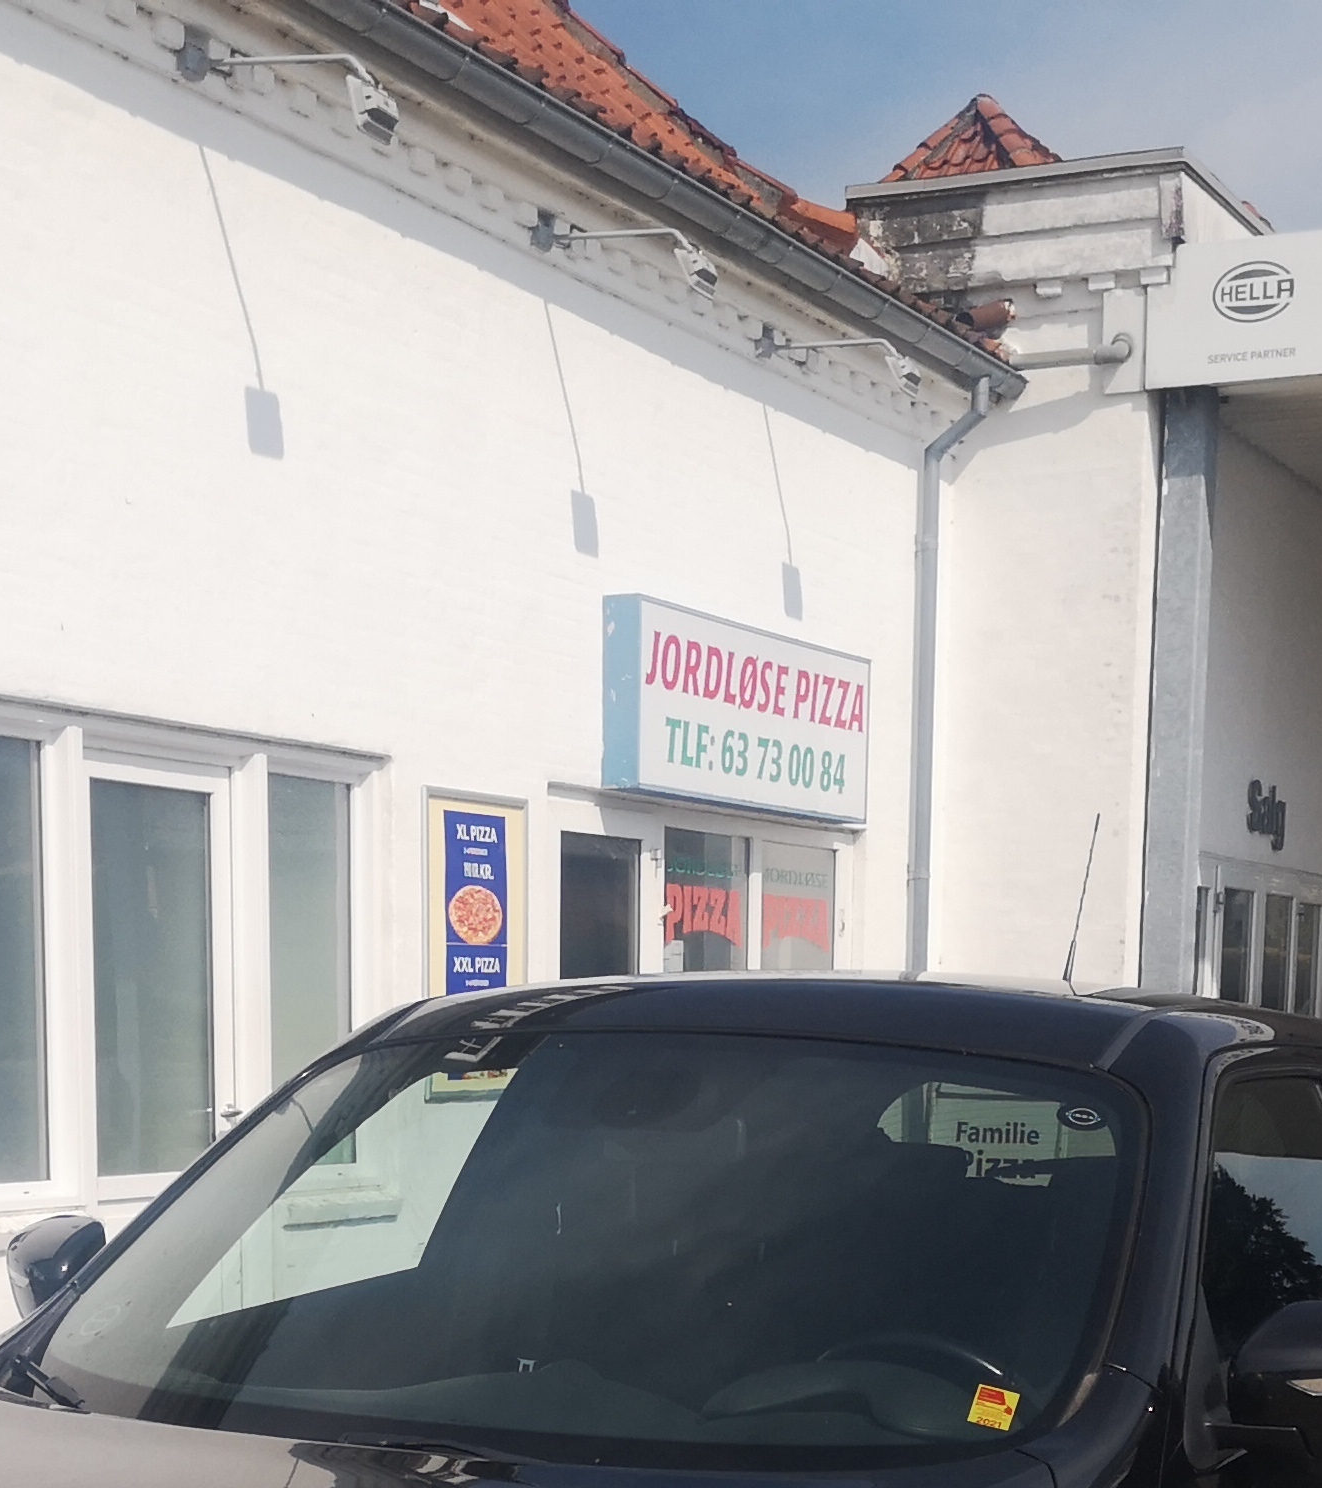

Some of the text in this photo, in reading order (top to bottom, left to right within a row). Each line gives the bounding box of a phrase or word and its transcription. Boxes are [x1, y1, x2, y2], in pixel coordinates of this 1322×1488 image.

[1220, 278, 1295, 304] HELLA
[1207, 346, 1296, 365] SERVICE PARTNER
[645, 629, 866, 733] JORDLØSE PIZZA
[664, 716, 846, 795] TLF: 63 73 00 84
[456, 823, 497, 843] XL PIZZA
[665, 883, 743, 949] PIZZA
[762, 893, 830, 954] PIZZA
[453, 956, 500, 974] XXL PIZZA
[955, 1121, 1041, 1145] Familie
[976, 1417, 1002, 1428] 2021
